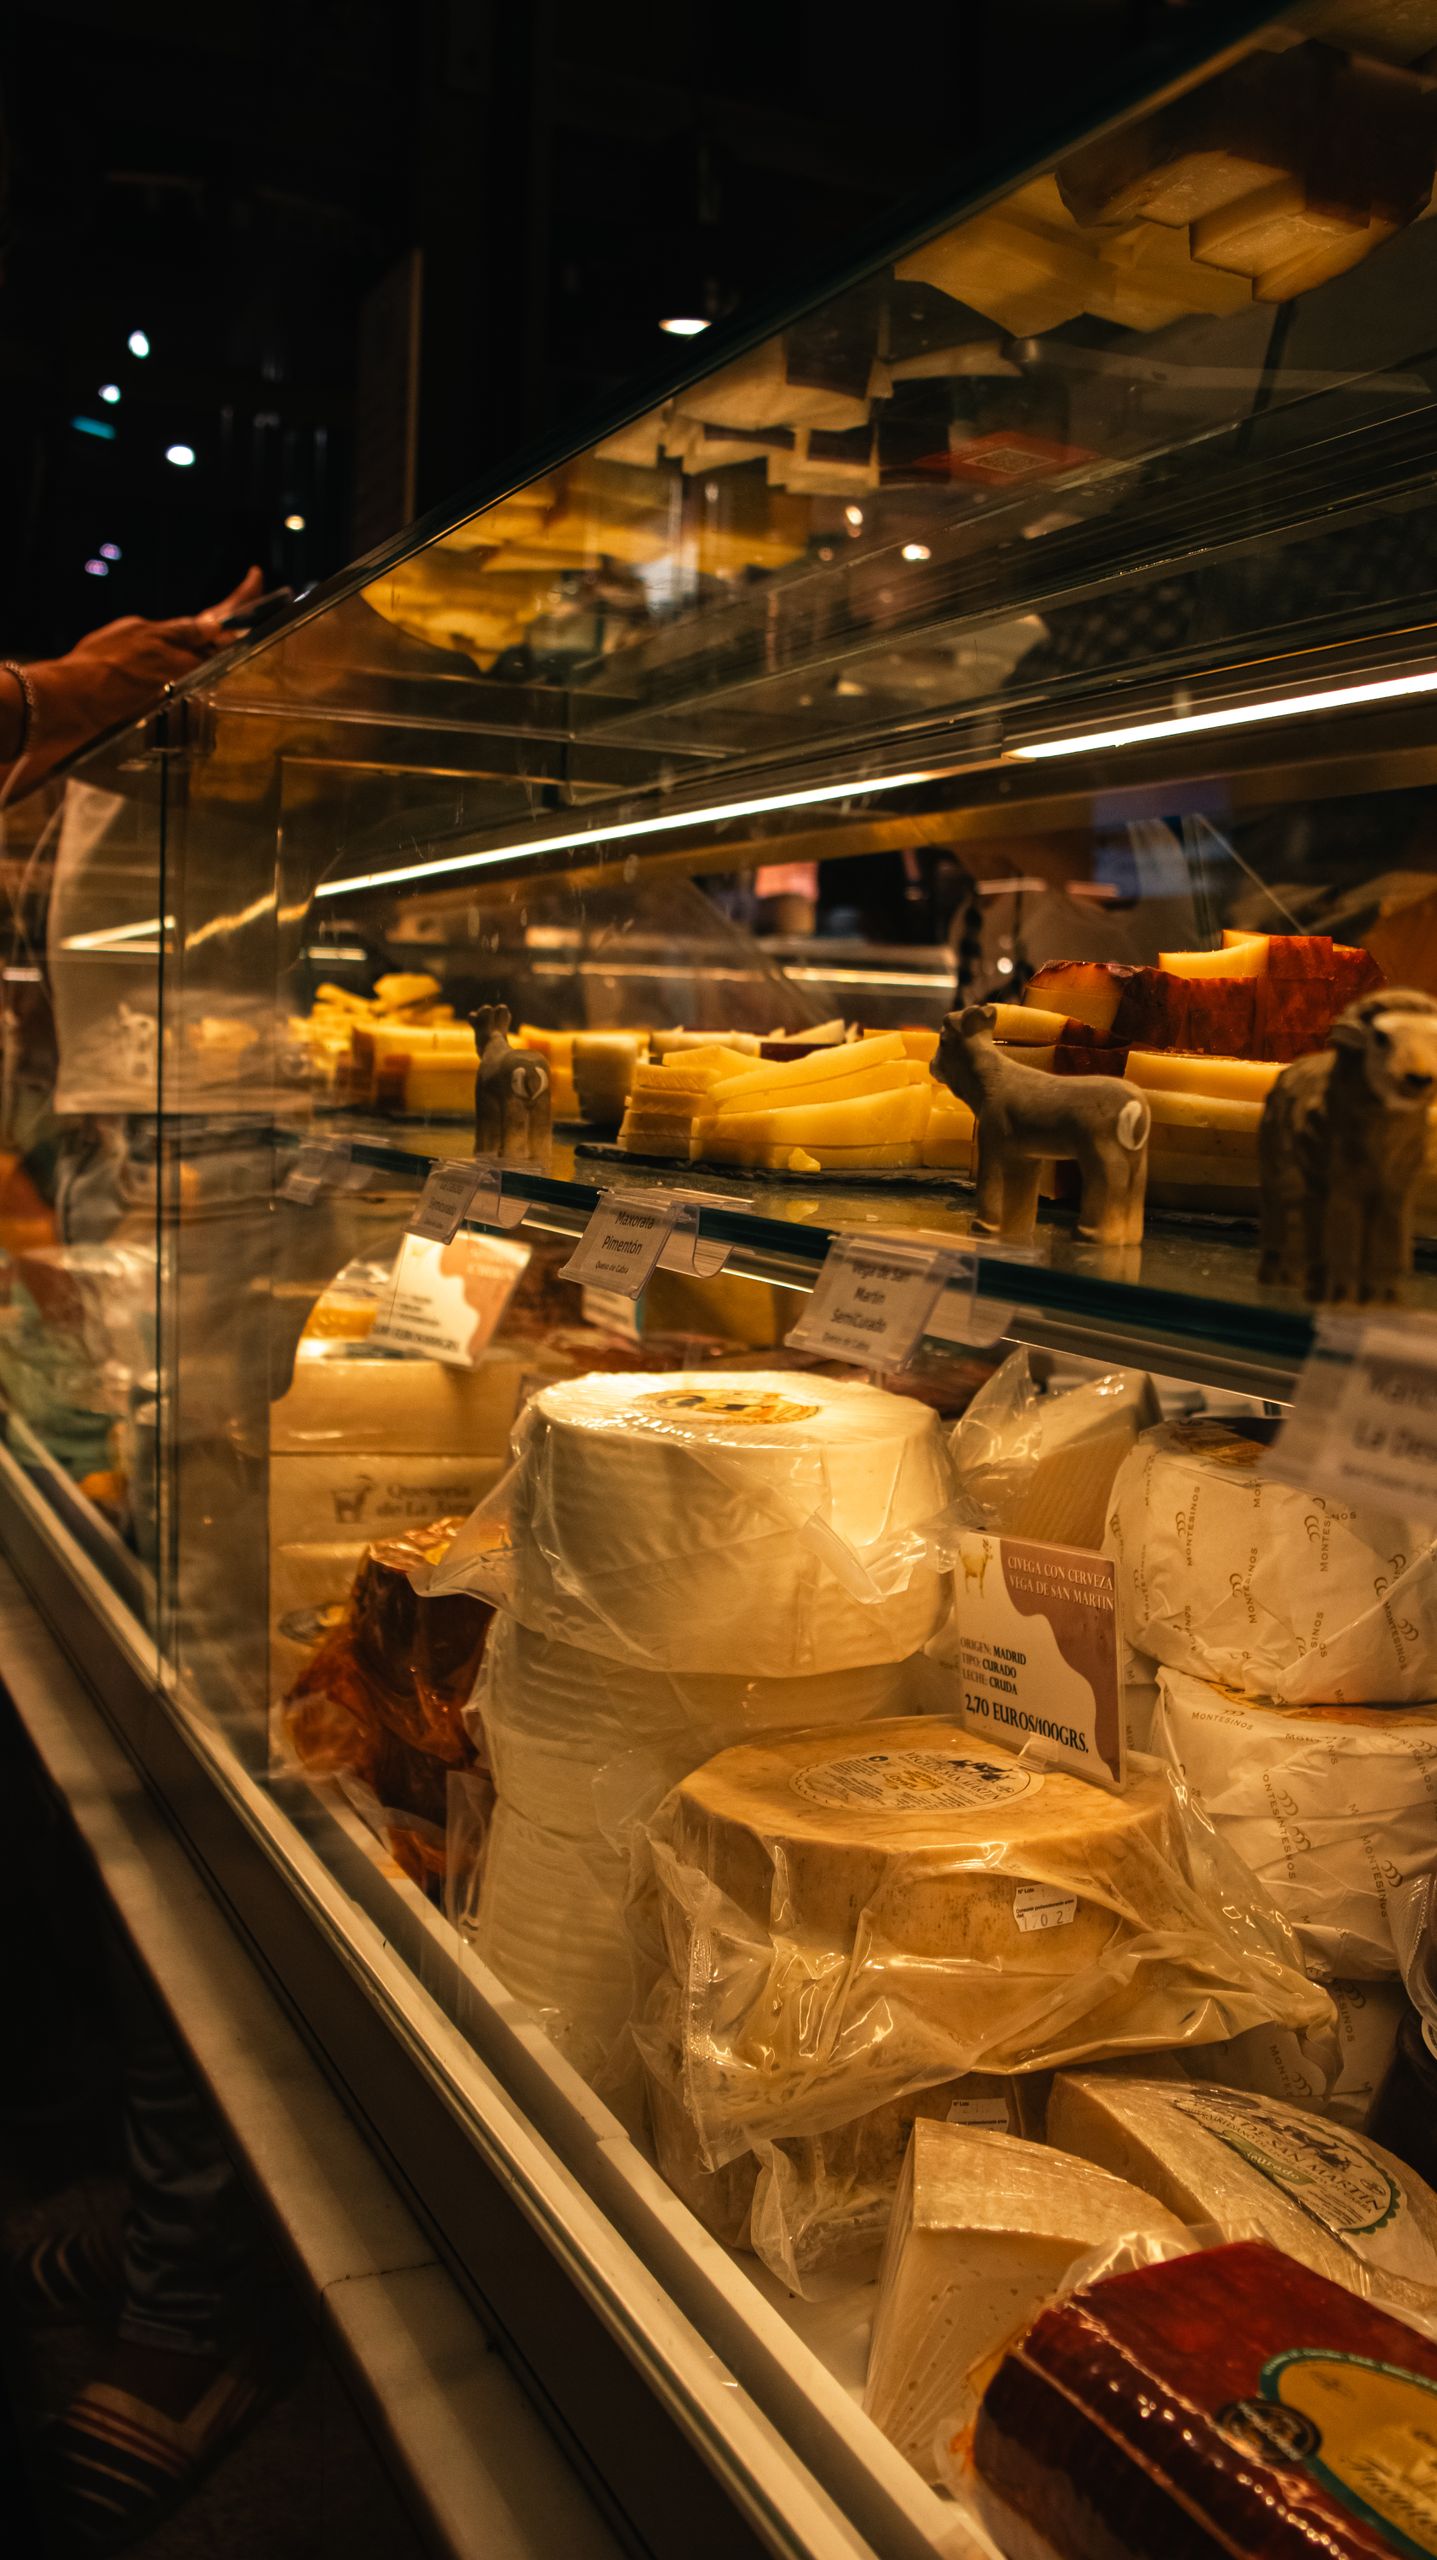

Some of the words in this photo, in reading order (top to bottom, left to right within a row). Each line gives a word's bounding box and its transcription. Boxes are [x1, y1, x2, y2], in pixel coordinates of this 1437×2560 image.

[614, 1210, 655, 1229] Maxorata
[601, 1235, 643, 1256] Pimentón
[1185, 1486, 1200, 1567] MONTESINOS
[1008, 1556, 1041, 1575] CIVEGA
[1044, 1563, 1066, 1580] CON
[1067, 1569, 1114, 1591] CERVEZA
[1243, 1547, 1258, 1624] MONTESINOS
[1009, 1575, 1034, 1594] VEGA
[1036, 1581, 1050, 1597] DE
[1050, 1585, 1070, 1601] SAN
[1073, 1589, 1114, 1611] MARTIN
[960, 1637, 991, 1655] ORIGEN:
[993, 1645, 1027, 1666] MADRID
[1383, 1601, 1408, 1671] MONTESINOS
[961, 1653, 981, 1665] TIPO:
[982, 1658, 1017, 1679] CURADO
[962, 1669, 988, 1686] LECHE:
[989, 1677, 1018, 1695] CRUDA
[965, 1693, 990, 1717] 2,70
[993, 1702, 1089, 1754] EUROS/100GRS.
[1191, 1711, 1254, 1731] MONTESINOS
